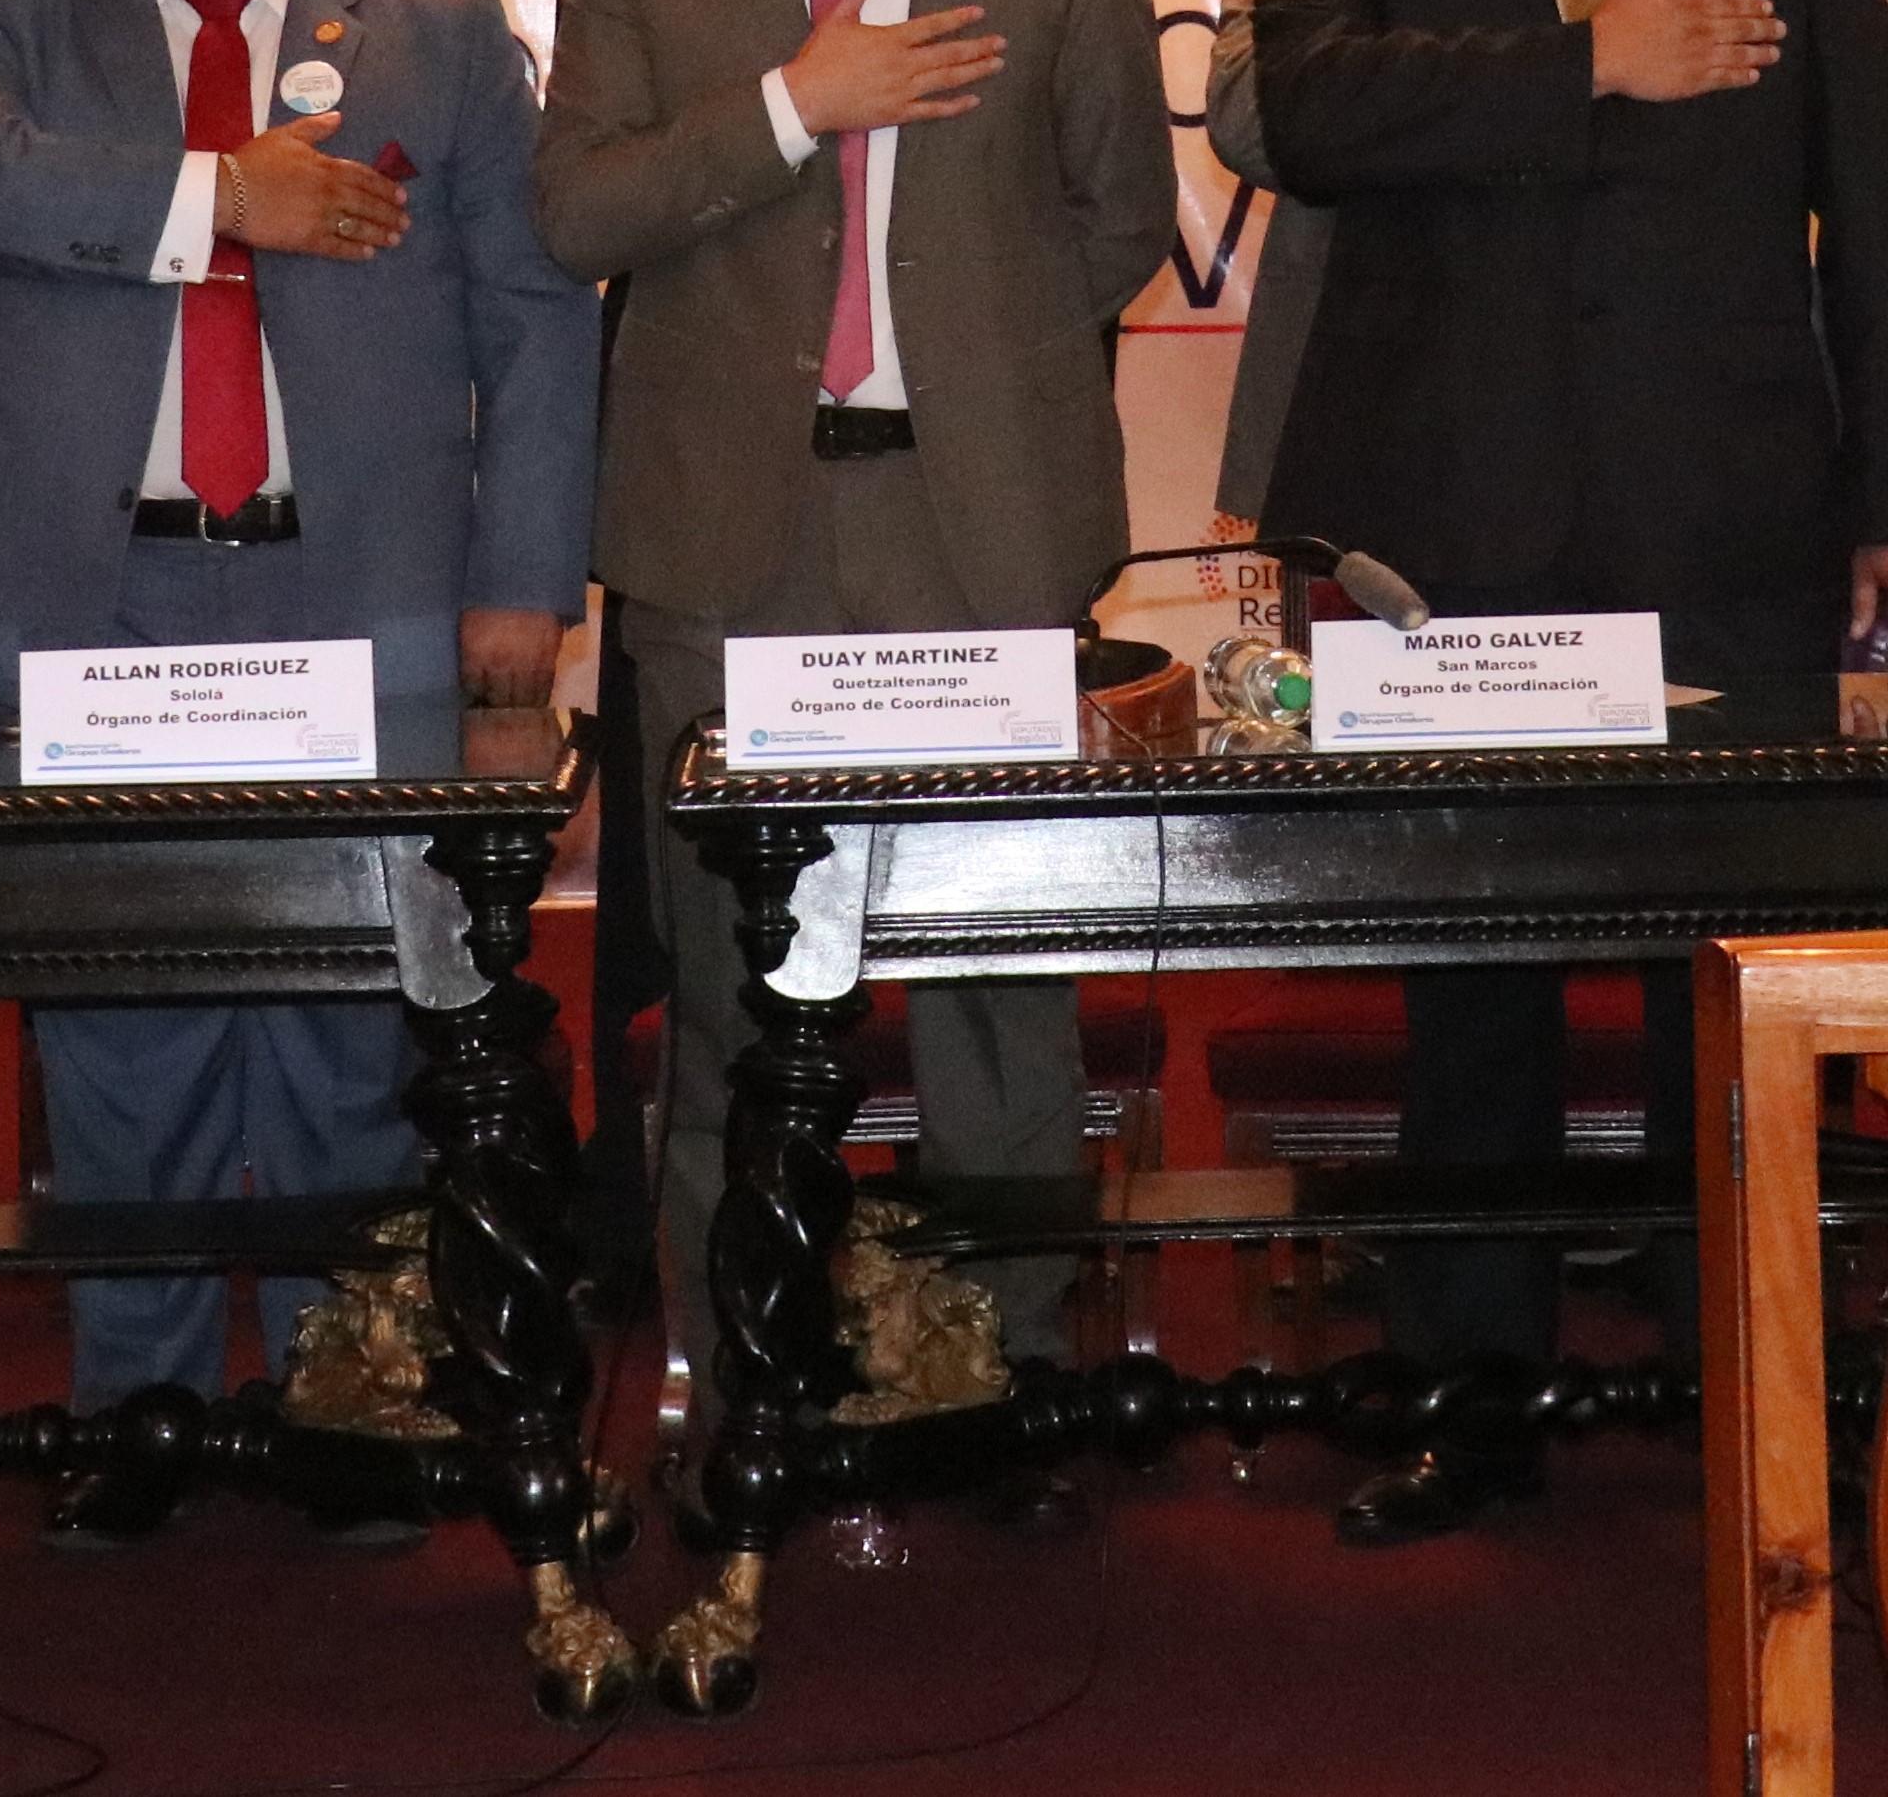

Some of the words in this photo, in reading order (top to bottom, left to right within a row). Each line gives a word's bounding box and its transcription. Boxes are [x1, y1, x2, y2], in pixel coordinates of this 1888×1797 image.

[1404, 632, 1482, 651] MARIO
[1489, 630, 1584, 649] GALVEZ
[801, 650, 868, 669] DUAY
[875, 646, 999, 666] MARTINEZ
[1436, 659, 1470, 673] San
[1474, 658, 1538, 671] Marcos
[82, 663, 161, 682] ALLAN
[169, 657, 310, 680] RODRÍGUEZ
[831, 674, 969, 691] Quetzaltenango
[1379, 679, 1445, 698] Órgano
[1450, 681, 1473, 694] de
[1477, 677, 1599, 694] Coordinación
[170, 688, 224, 702] Sololá
[790, 697, 856, 716] Órgano
[861, 698, 885, 711] de
[889, 695, 1011, 711] Coordinación
[86, 710, 153, 728] Órgano
[158, 712, 181, 725] de
[186, 707, 308, 724] Coordinación
